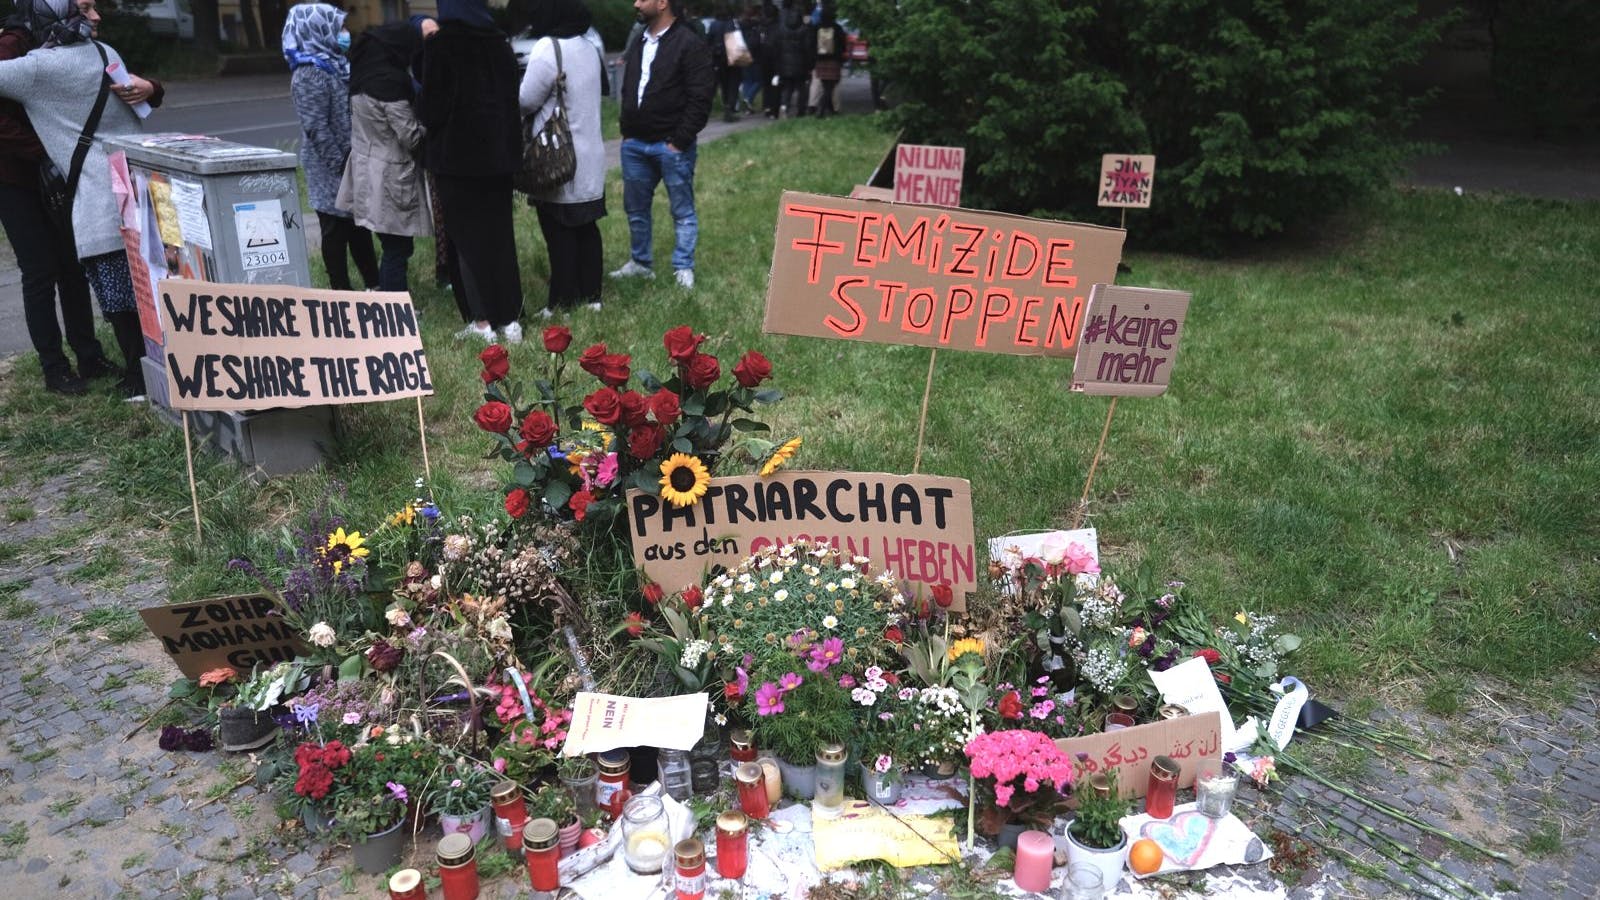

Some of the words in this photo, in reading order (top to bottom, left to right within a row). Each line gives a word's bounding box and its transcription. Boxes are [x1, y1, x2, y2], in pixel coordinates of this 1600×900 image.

[923, 147, 962, 171] UNA
[1114, 159, 1142, 173] JIN
[896, 172, 960, 207] MENOS
[1105, 176, 1149, 188] JIYAN
[246, 252, 285, 267] 23004
[163, 293, 217, 336] WE
[215, 295, 300, 337] SHARE
[302, 299, 356, 338] THE
[356, 300, 417, 338] PAIN
[823, 275, 1083, 349] STOPPEN
[1084, 303, 1178, 350] #keine
[168, 353, 224, 398] WE
[222, 355, 310, 399] SHARE
[310, 357, 367, 397] THE
[366, 350, 433, 395] RAGE
[1097, 347, 1167, 383] mehr
[633, 479, 953, 536] PATRIARCHAT
[644, 543, 686, 561] aus
[694, 527, 739, 556] den
[883, 536, 974, 585] HEBEN
[172, 597, 287, 628] ZOHR
[602, 700, 617, 729] NEIN
